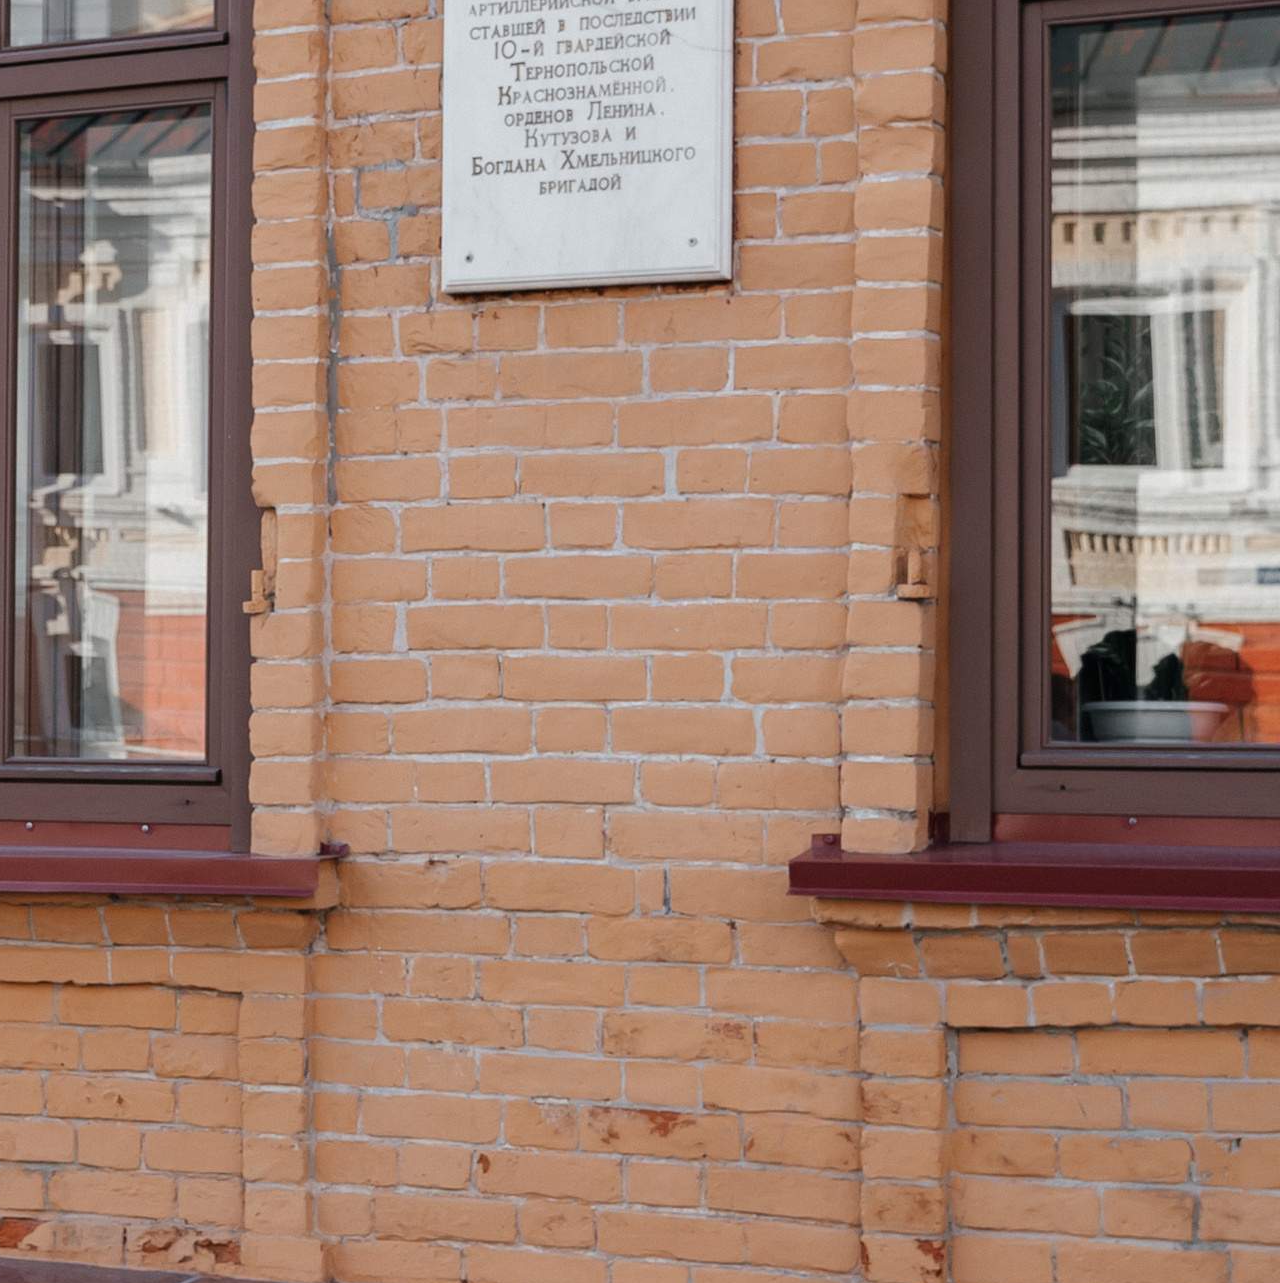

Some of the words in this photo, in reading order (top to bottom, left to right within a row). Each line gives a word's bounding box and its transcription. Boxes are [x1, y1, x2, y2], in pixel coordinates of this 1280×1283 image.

[470, 19, 545, 41] СТАВШЕЙ
[558, 19, 565, 33] В
[579, 7, 696, 31] ПОСЛЕДСТВИИ
[556, 29, 670, 55] ГВАРДЕЙСКОЙ
[504, 109, 574, 127] ОРДЕНОВ
[625, 126, 636, 140] И
[539, 174, 622, 195] БРИГАДОЙ
